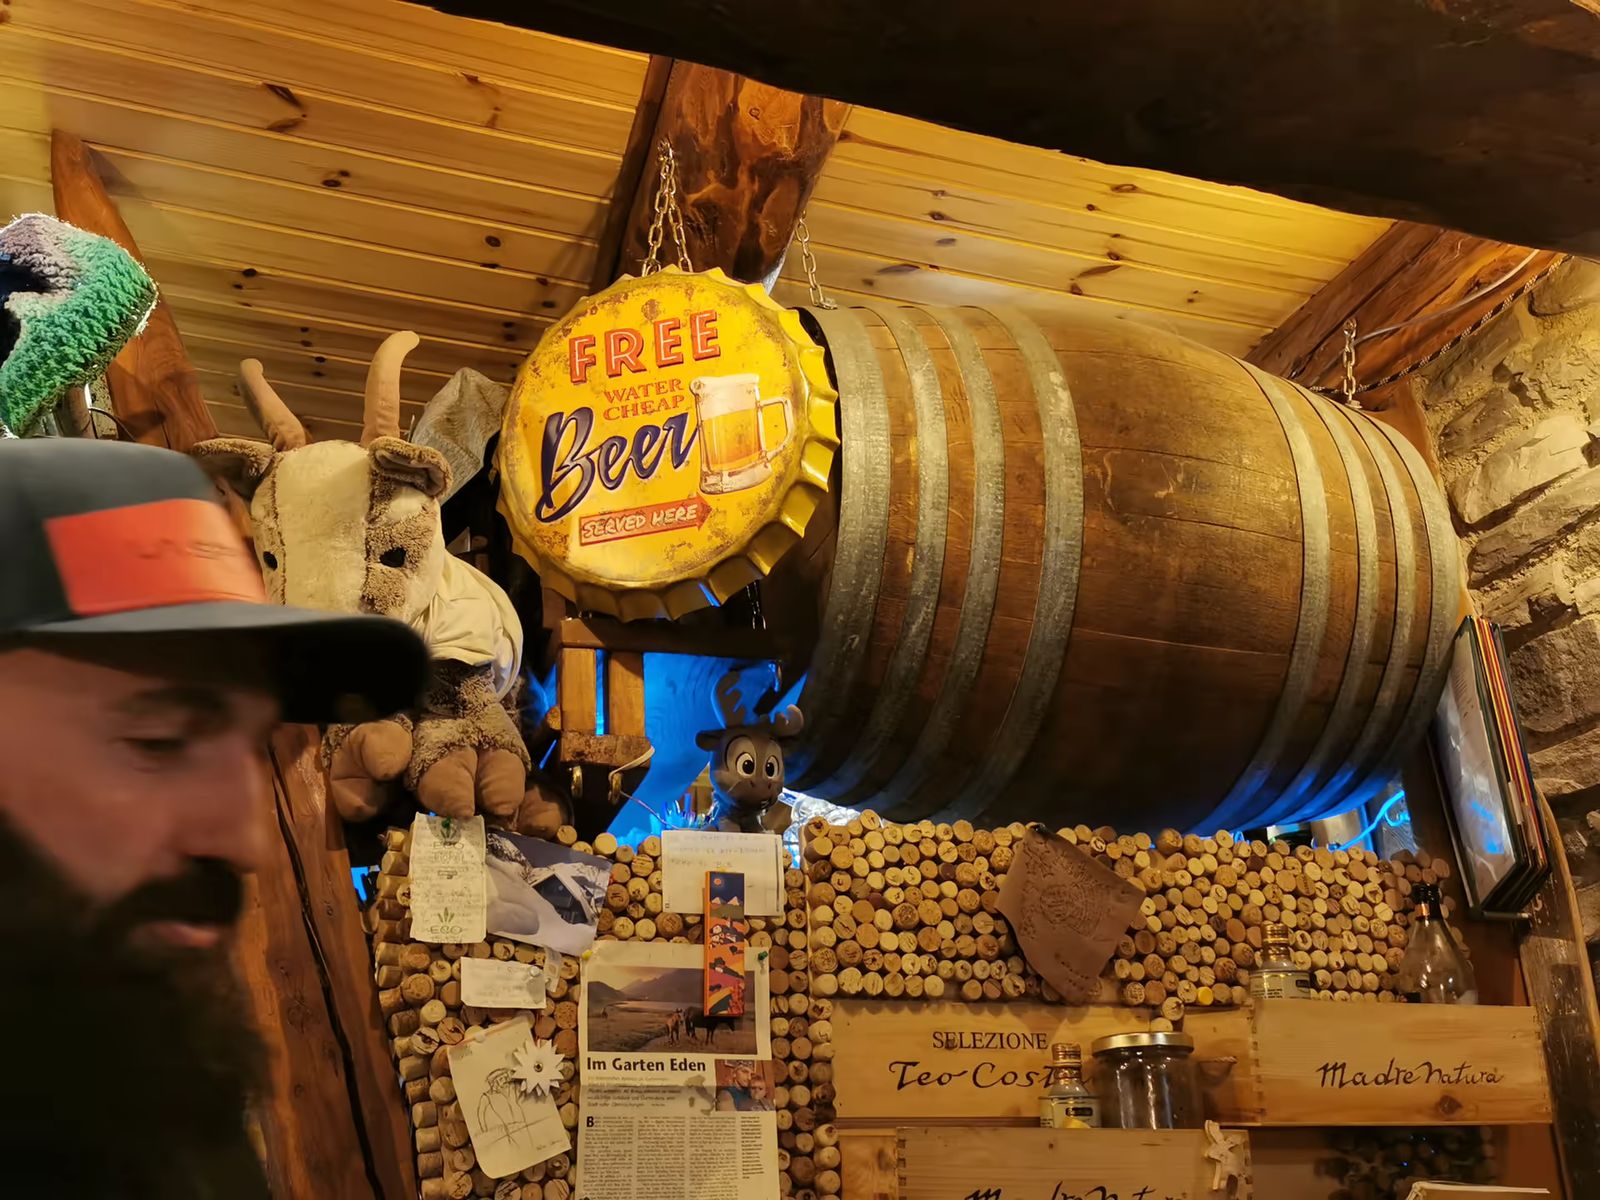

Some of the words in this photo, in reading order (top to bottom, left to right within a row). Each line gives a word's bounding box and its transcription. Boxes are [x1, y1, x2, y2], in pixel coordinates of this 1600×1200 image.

[569, 309, 721, 386] FREE
[603, 378, 685, 403] WATER
[603, 395, 686, 421] CHEAP
[535, 407, 699, 523] Beer
[583, 513, 646, 538] SERVED
[651, 504, 698, 526] HERE
[932, 1031, 1049, 1050] SELEZIONE
[587, 1057, 606, 1070] Im
[612, 1057, 665, 1072] Garten
[670, 1057, 706, 1072] Eden
[888, 1060, 968, 1091] Teo
[972, 1061, 1093, 1090] Cost
[1316, 1057, 1421, 1088] Madre
